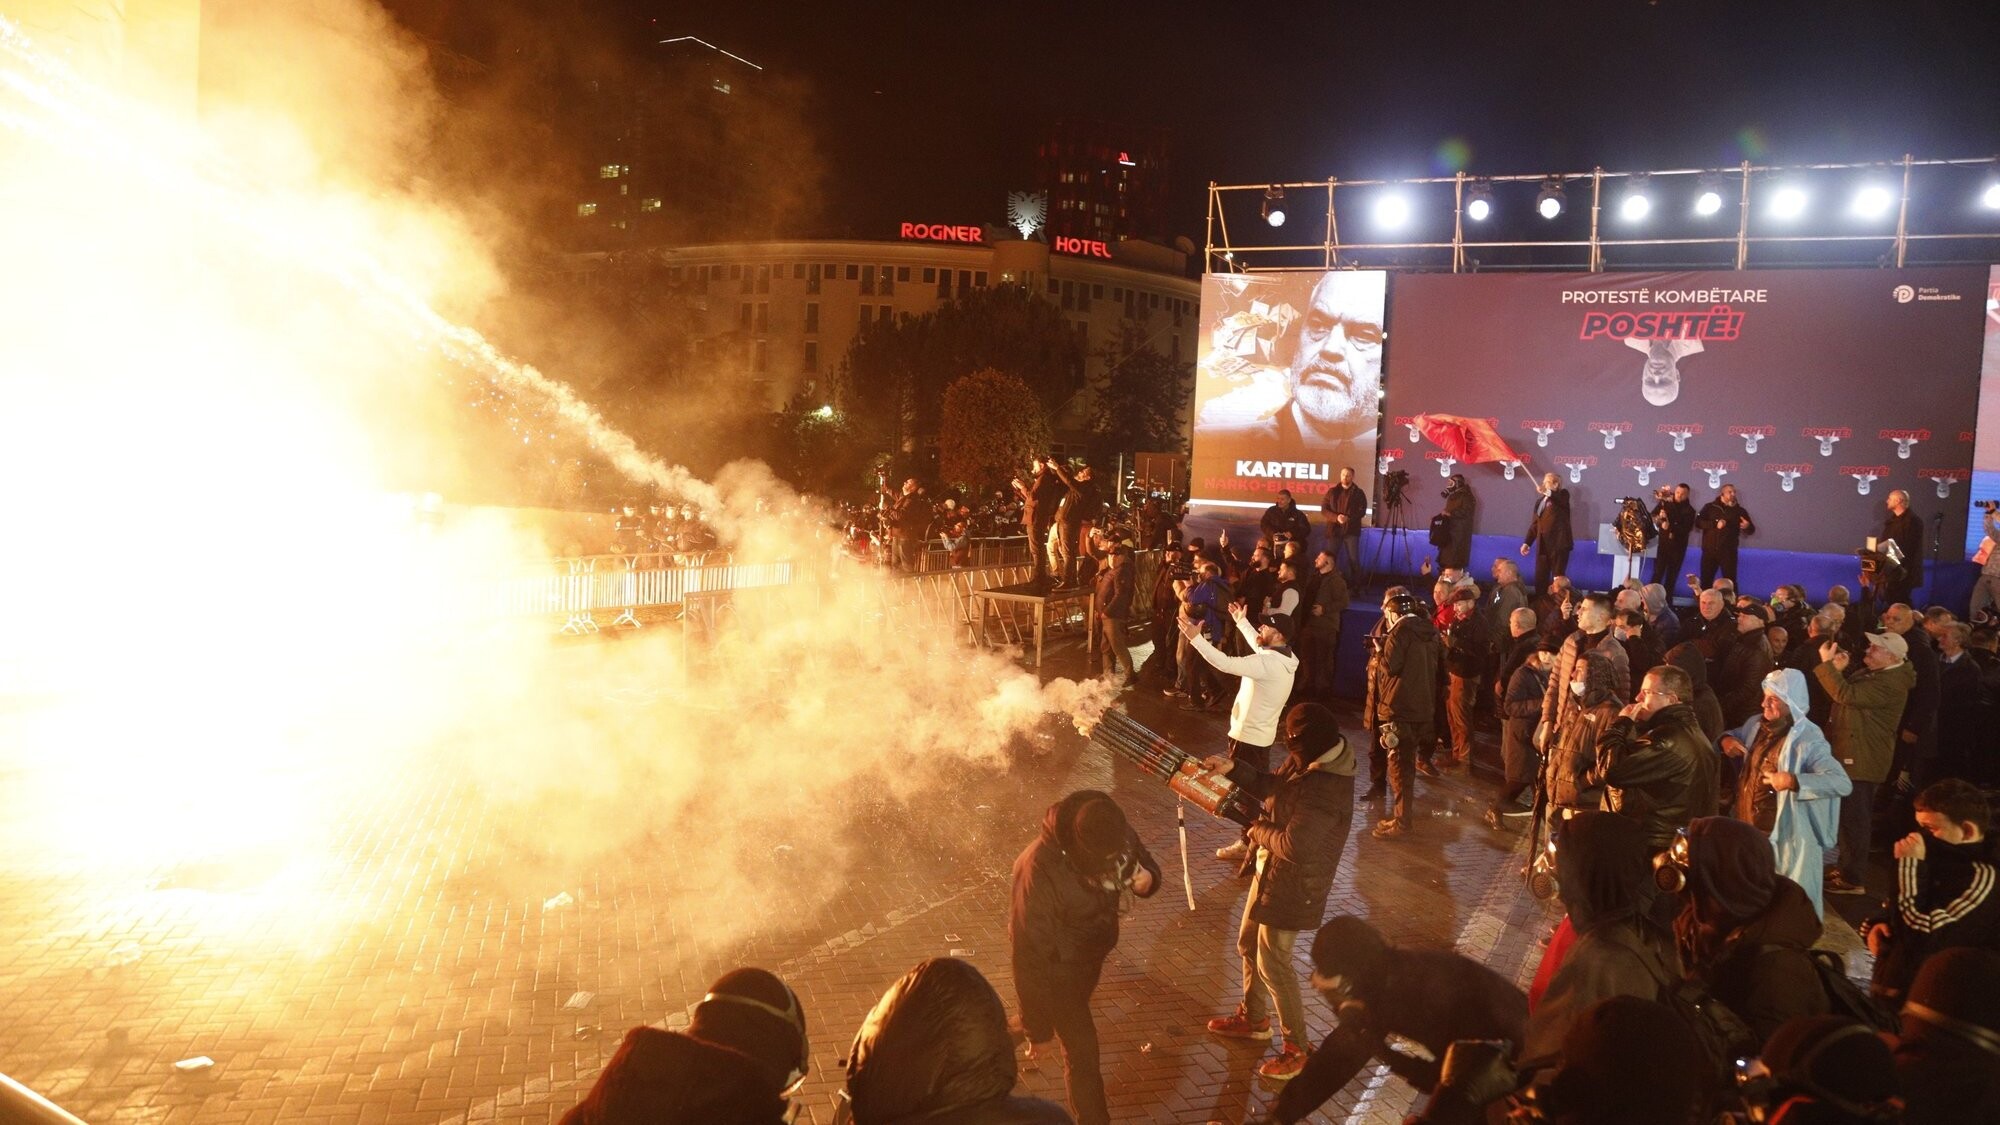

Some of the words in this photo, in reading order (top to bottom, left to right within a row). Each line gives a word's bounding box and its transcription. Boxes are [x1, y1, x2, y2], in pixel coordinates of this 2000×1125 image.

[901, 222, 983, 242] ROGNER
[1056, 235, 1112, 258] HOTEL
[1562, 288, 1650, 303] PROTESTË
[1655, 287, 1768, 303] KOMBËTARE
[1580, 304, 1746, 340] POSHTË!
[1236, 460, 1330, 480] KARTELI
